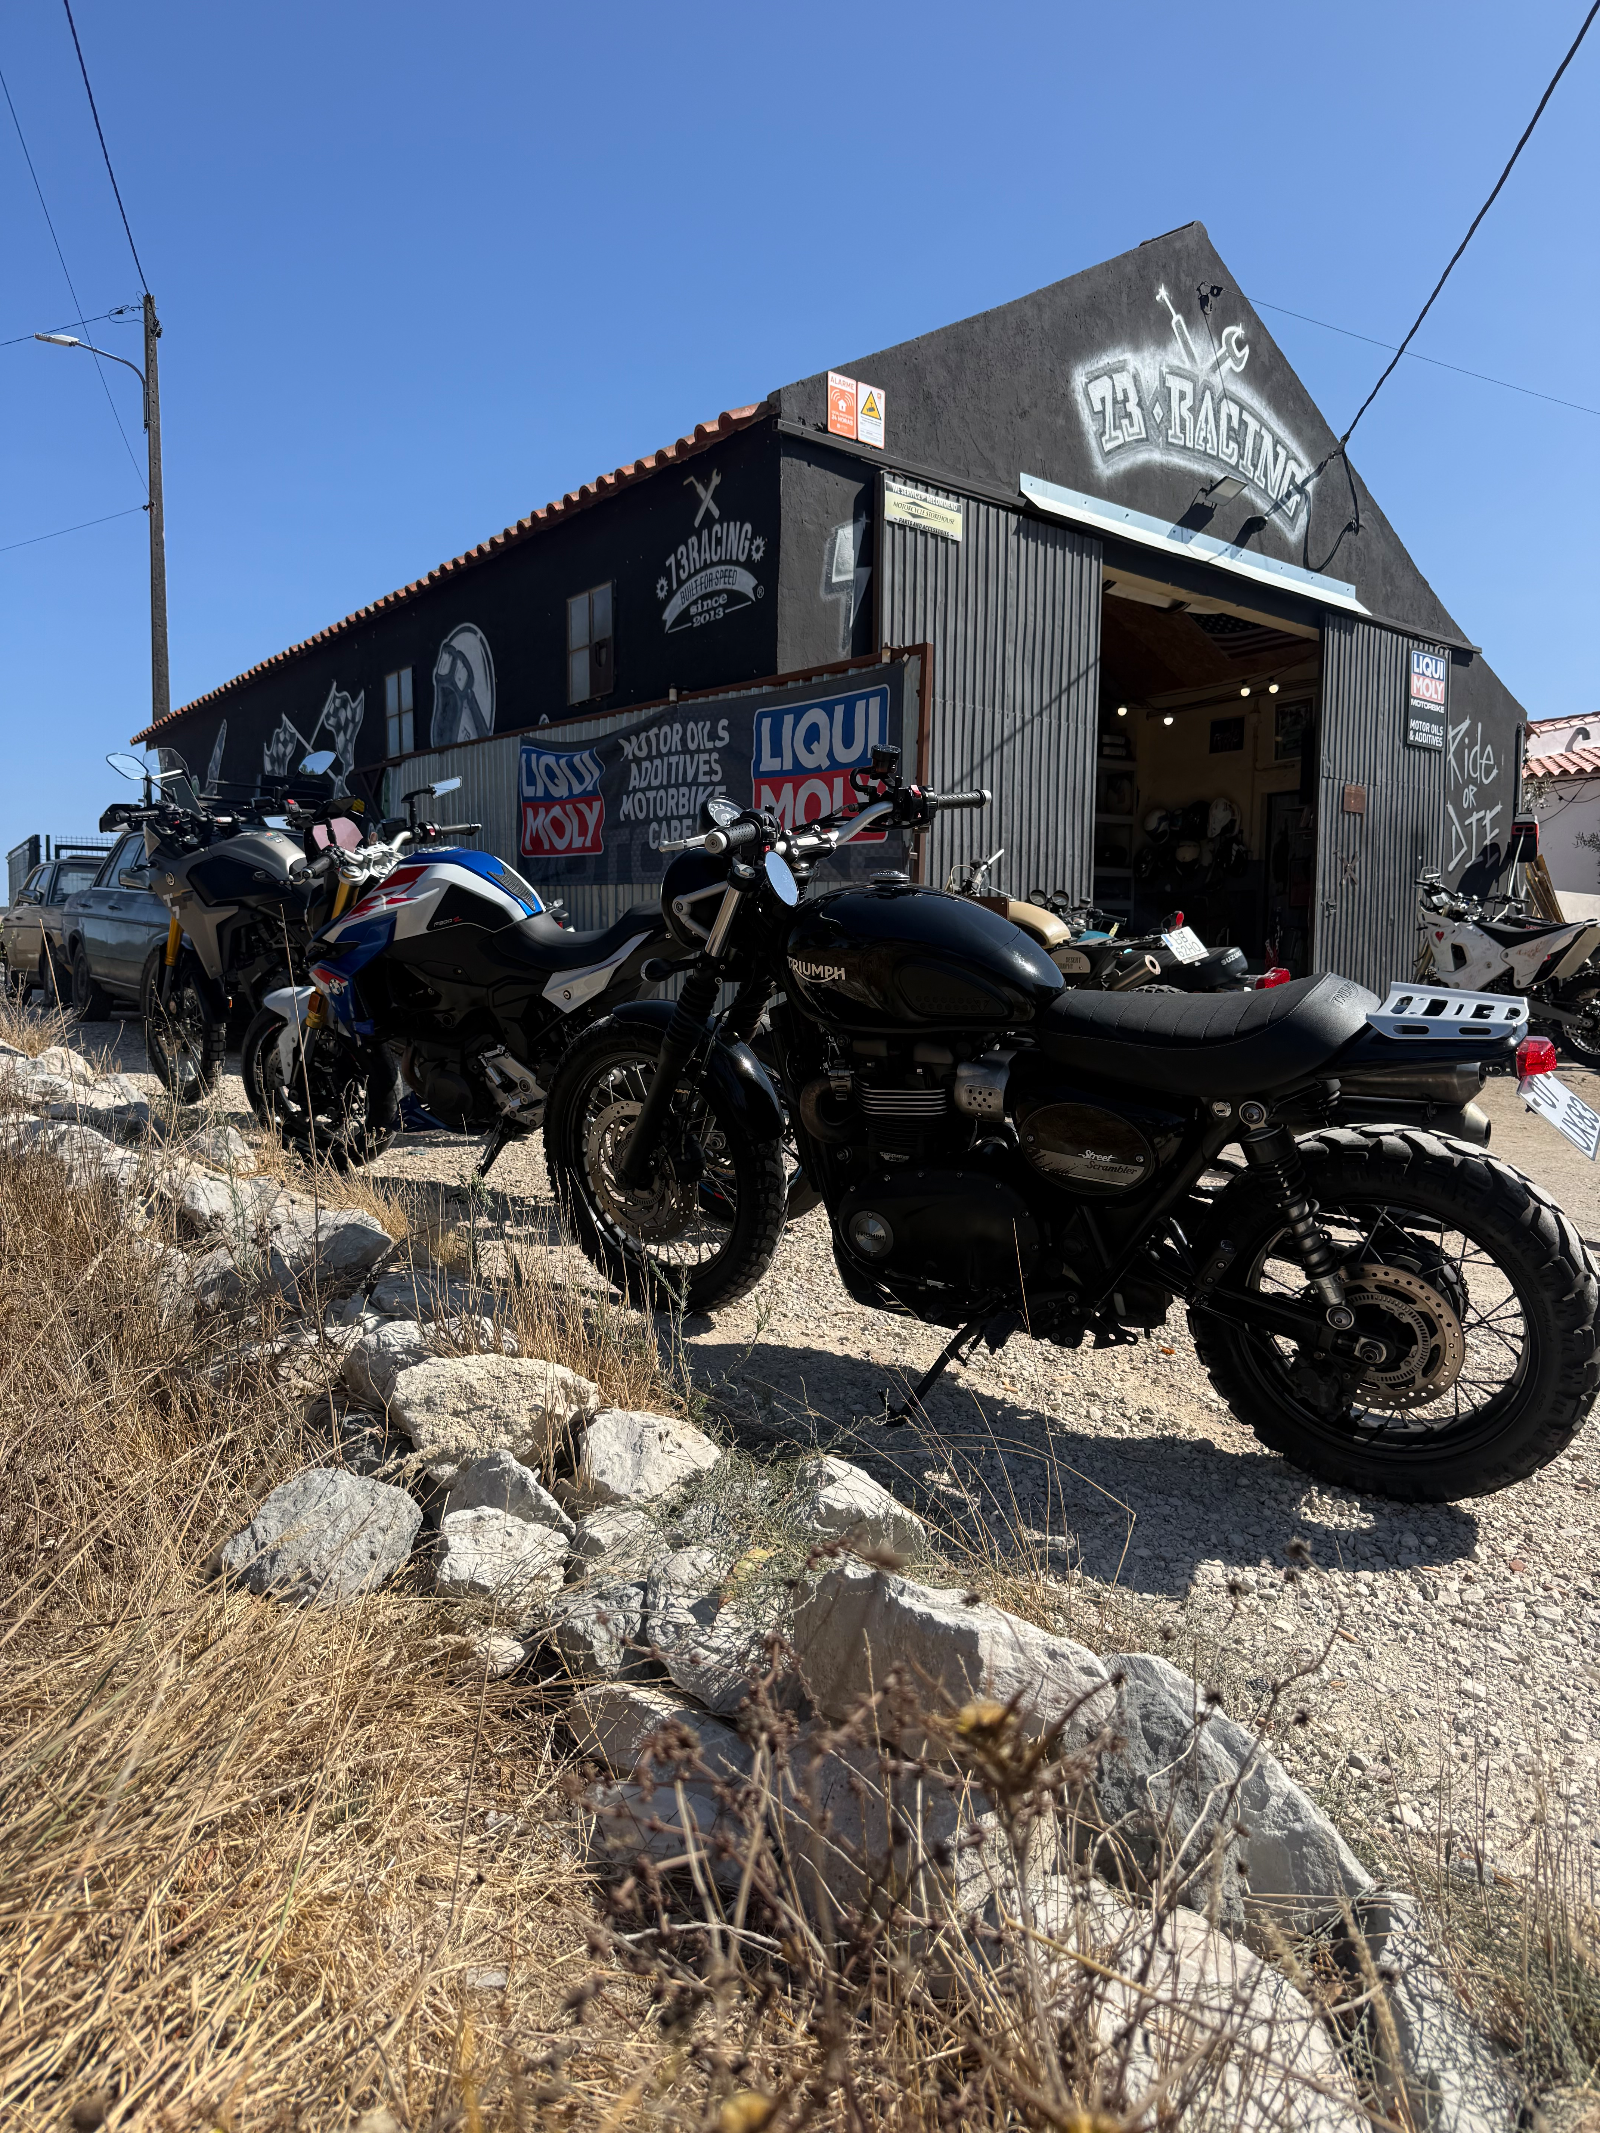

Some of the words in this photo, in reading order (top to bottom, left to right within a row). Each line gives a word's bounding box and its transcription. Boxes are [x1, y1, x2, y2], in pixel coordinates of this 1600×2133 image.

[830, 375, 855, 391] ALARME
[1165, 374, 1303, 518] RACING
[893, 501, 925, 516] MOTORCYCLE
[898, 517, 912, 526] PARTS
[912, 521, 922, 529] AND
[665, 521, 752, 591] 73RACING
[680, 578, 698, 606] BUILT
[698, 571, 713, 592] FOR
[714, 568, 738, 587] SPEED
[689, 593, 728, 616] since
[692, 606, 724, 628] 2013
[1413, 653, 1444, 680] LIQUI
[1413, 675, 1444, 700] MOLY
[1410, 698, 1445, 714] MOTORBIKE
[618, 721, 682, 762] MOTOR
[686, 718, 730, 750] OILS
[760, 696, 880, 772] LIQUI
[1409, 730, 1414, 741] &
[1414, 731, 1443, 747] ADDITIVES
[1410, 718, 1430, 733] MOTOR
[1430, 723, 1444, 736] OILS
[1447, 714, 1499, 791] Ride
[521, 749, 601, 800] LIQUI
[628, 752, 723, 791] ADDITIVES
[1462, 784, 1478, 809] OR
[524, 801, 602, 851] MOLY
[648, 818, 693, 850] CARE
[1446, 800, 1503, 872] DIE
[786, 955, 846, 983] TRIUMPH
[1220, 950, 1242, 966] SUZUK
[1084, 1160, 1138, 1176] Scrambler
